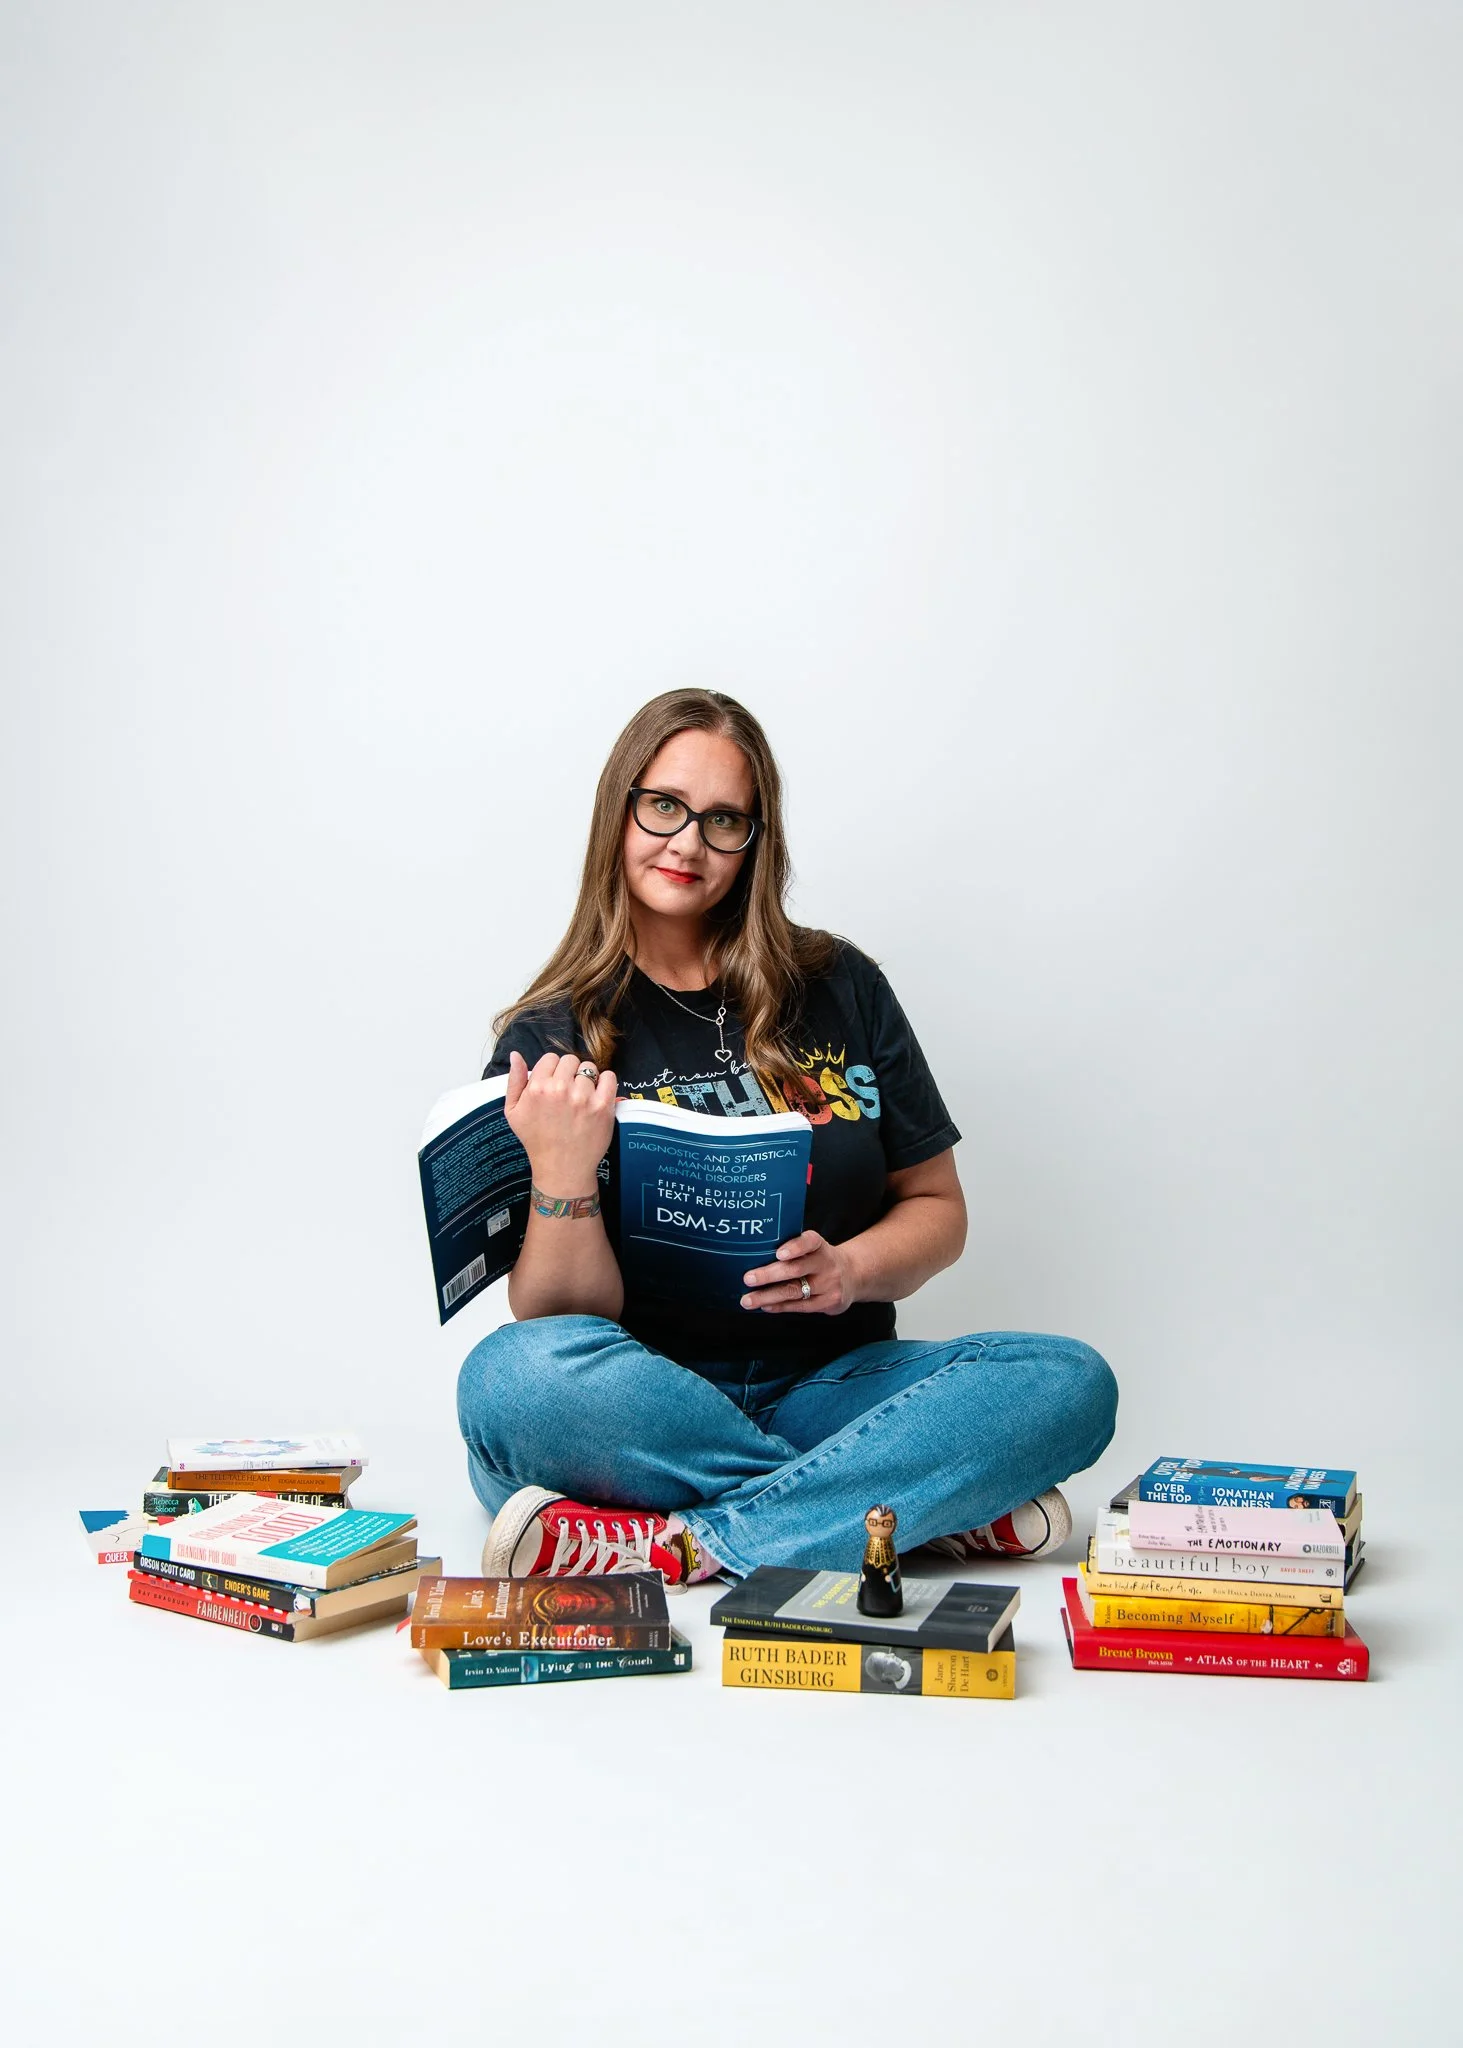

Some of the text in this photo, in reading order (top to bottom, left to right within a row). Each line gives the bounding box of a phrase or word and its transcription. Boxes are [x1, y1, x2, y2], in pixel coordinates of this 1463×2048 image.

[624, 1068, 677, 1090] must
[679, 1070, 727, 1082] now
[628, 1141, 798, 1163] DIAGNOSTIC AND STATISTICAL
[658, 1165, 767, 1184] MENTAL DISORDERS
[677, 1159, 748, 1173] MANUAL OF
[658, 1179, 767, 1198] FIFTH EDITION
[657, 1188, 766, 1209] TEXT REVISION
[1147, 1491, 1168, 1502] THE
[1169, 1493, 1192, 1504] TOP
[1154, 1482, 1184, 1494] OVER
[1211, 1487, 1274, 1501] JONATHAN
[208, 1493, 226, 1506] THE
[1215, 1497, 1271, 1509] VAN NESS
[1187, 1538, 1281, 1552] THE EMOTIONARY
[105, 1551, 129, 1562] QUEER
[1114, 1550, 1269, 1579] beautiful boy
[140, 1556, 195, 1580] ORSON SCOTT CARD
[138, 1589, 190, 1607] RAY BRADBURY
[224, 1579, 270, 1601] ENDER'S GAME
[196, 1600, 248, 1627] FAHRENHEIT
[1117, 1609, 1183, 1625] Becoming
[1190, 1612, 1235, 1626] Myself
[463, 1630, 613, 1648] Love's Executioner
[729, 1646, 847, 1666] RUTH BADER
[1099, 1646, 1174, 1660] Brené Brown
[1197, 1655, 1233, 1666] ATLAS
[1250, 1660, 1267, 1668] THE
[1270, 1659, 1310, 1670] HEART
[465, 1666, 520, 1676] Irvin D. Yalom
[540, 1662, 574, 1674] Lying
[578, 1662, 591, 1670] on
[616, 1655, 653, 1668] Couch
[935, 1661, 944, 1684] Jane
[947, 1655, 957, 1692] Sherron
[960, 1655, 970, 1692] De Hart
[740, 1668, 834, 1687] GINSBURG
